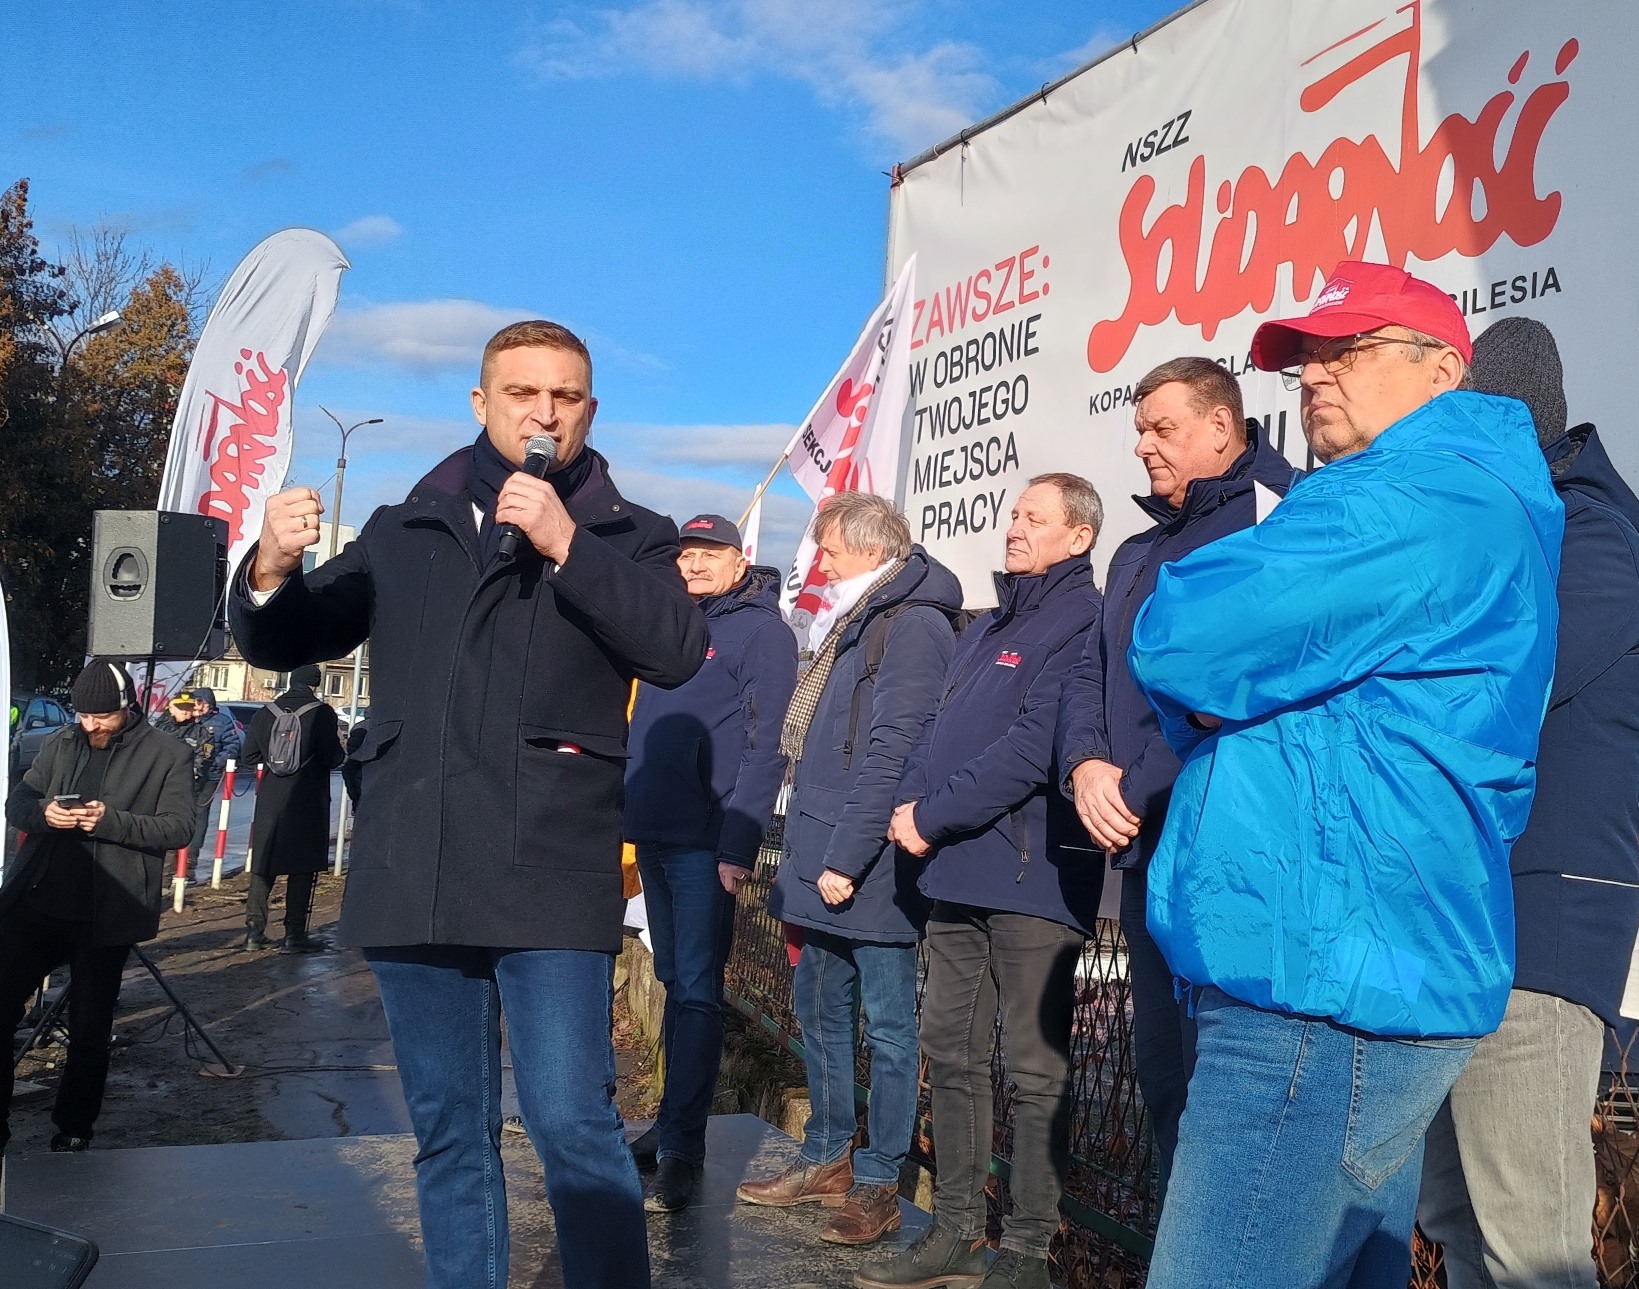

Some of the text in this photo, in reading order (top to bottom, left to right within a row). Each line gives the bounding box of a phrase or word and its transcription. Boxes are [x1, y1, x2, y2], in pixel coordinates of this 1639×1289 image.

[1121, 109, 1193, 173] NSZZ
[911, 244, 1050, 350] ZAWSZE:
[909, 357, 928, 398] W
[933, 312, 1043, 389] OBRONIE
[1089, 382, 1138, 416] KOPA
[1448, 266, 1562, 316] ILESIA
[914, 374, 1029, 445] TWOJEGO
[802, 423, 833, 478] SEKCJ
[913, 431, 1020, 495] MIEJSCA
[920, 488, 1007, 544] PRACY
